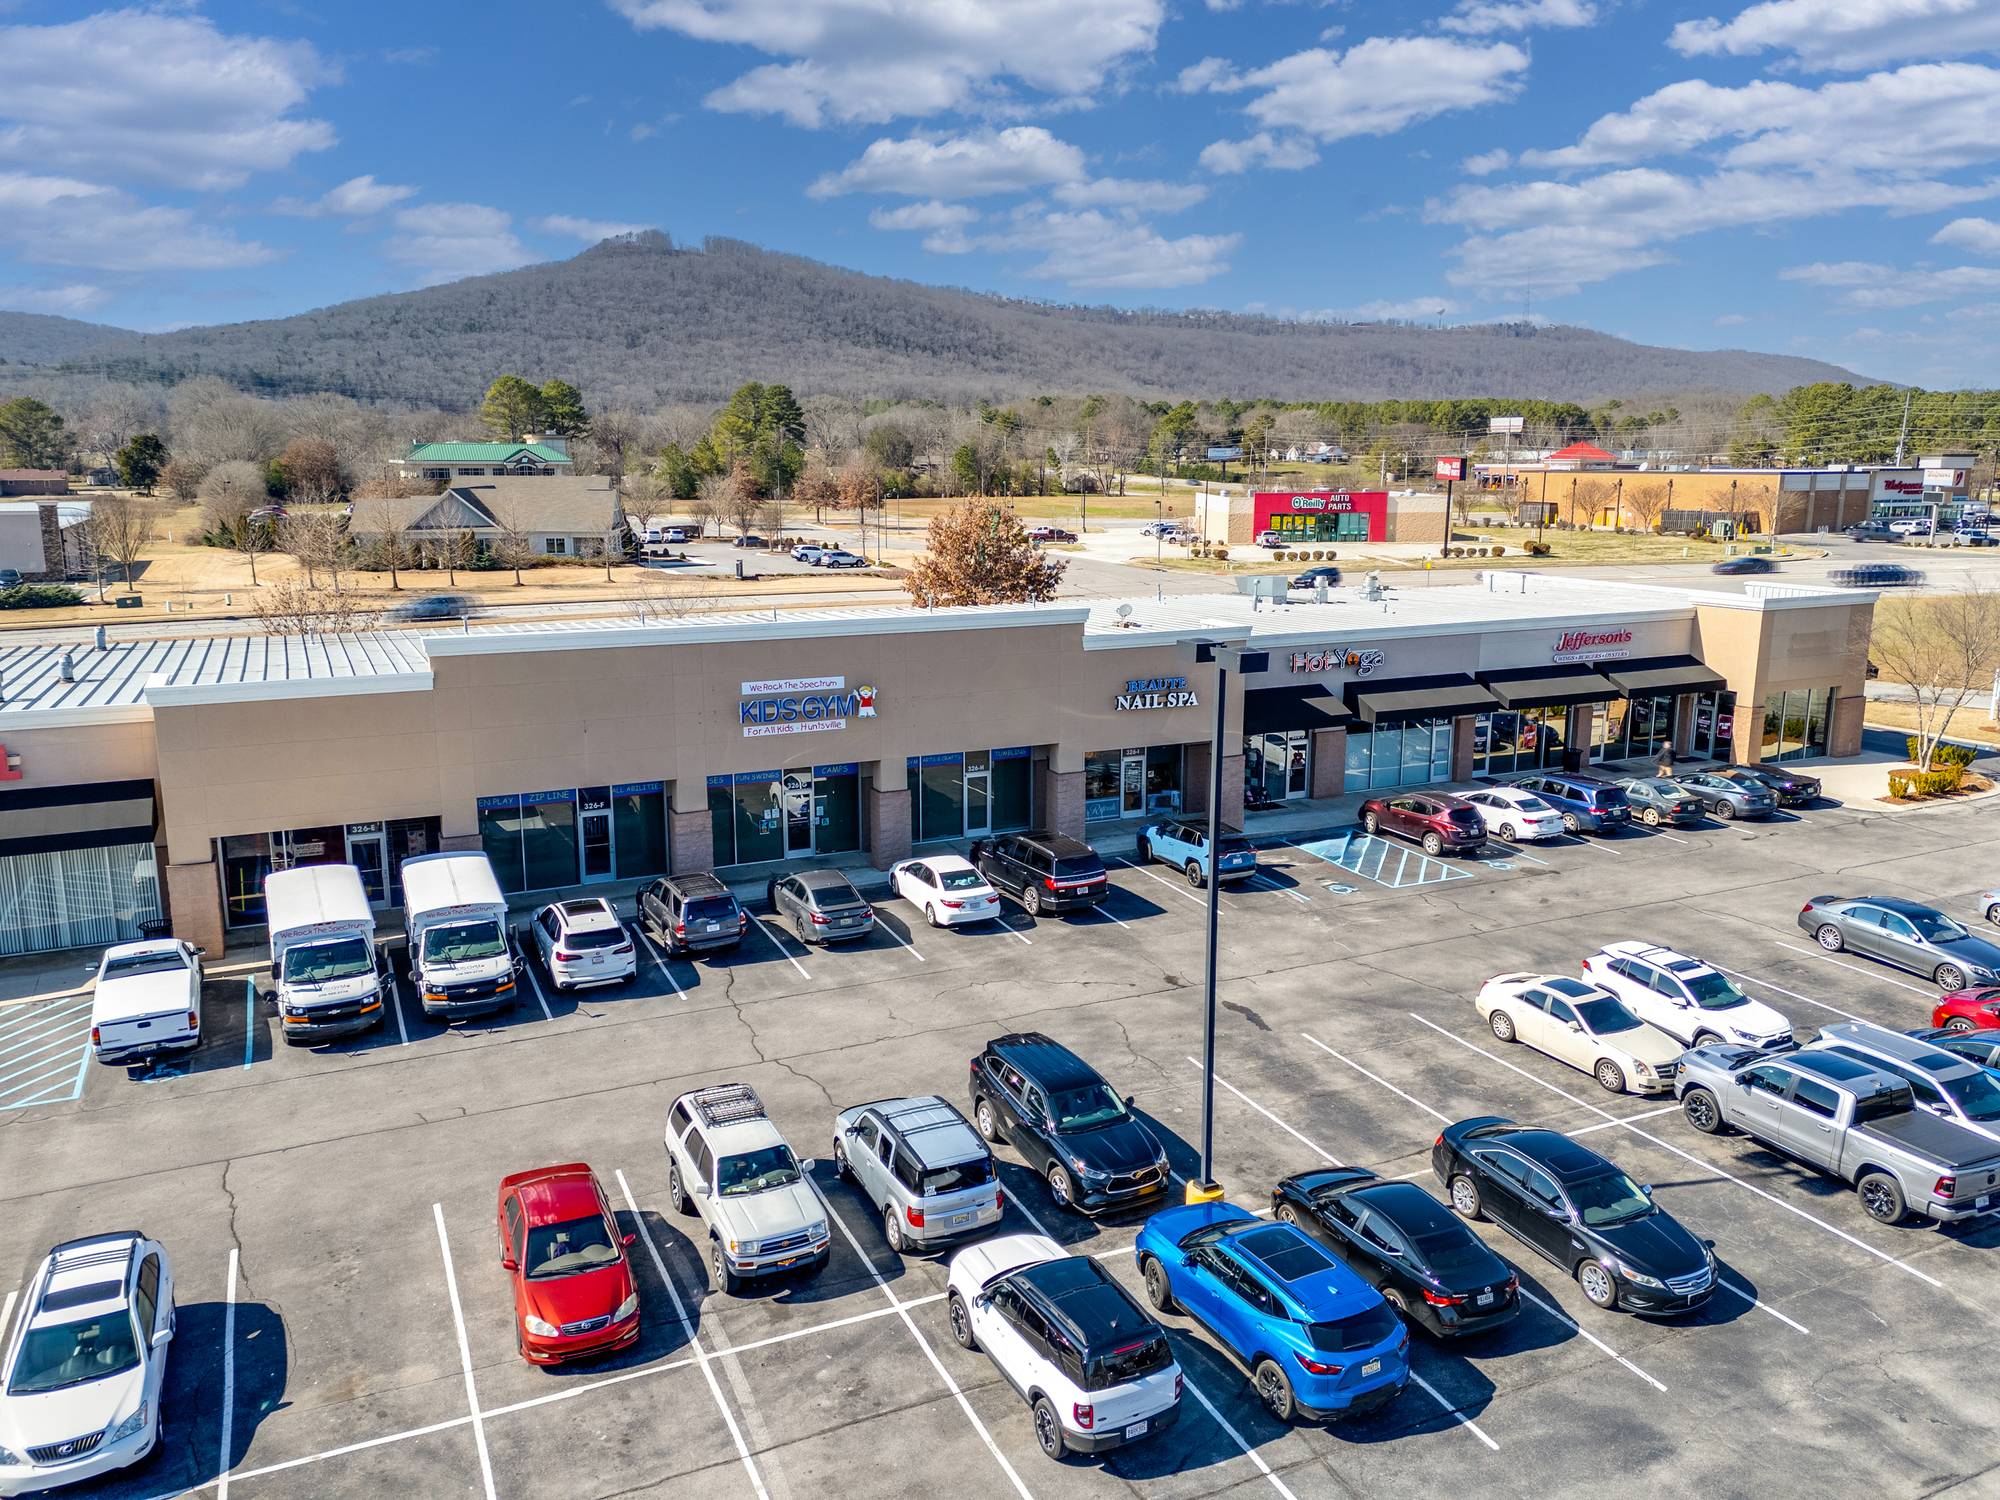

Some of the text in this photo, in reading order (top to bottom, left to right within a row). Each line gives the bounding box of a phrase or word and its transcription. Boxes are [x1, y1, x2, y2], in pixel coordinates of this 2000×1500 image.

[1292, 496, 1326, 509] O'Reilly
[1328, 502, 1352, 510] PARTS
[1554, 628, 1632, 651] Jefferson's
[1292, 647, 1385, 676] Hot Yoga
[749, 680, 838, 692] We Rock The Spectrum
[1126, 677, 1187, 693] BEAUTE
[1116, 691, 1199, 711] NAIL SPA
[740, 694, 857, 724] KID'S GYM
[747, 720, 842, 736] For All Kids Huntsville
[707, 777, 724, 785] SES
[751, 772, 781, 781] SWINGS
[492, 796, 514, 806] PLAY
[529, 791, 570, 802] ZIP LINE
[583, 801, 605, 810] 326-F
